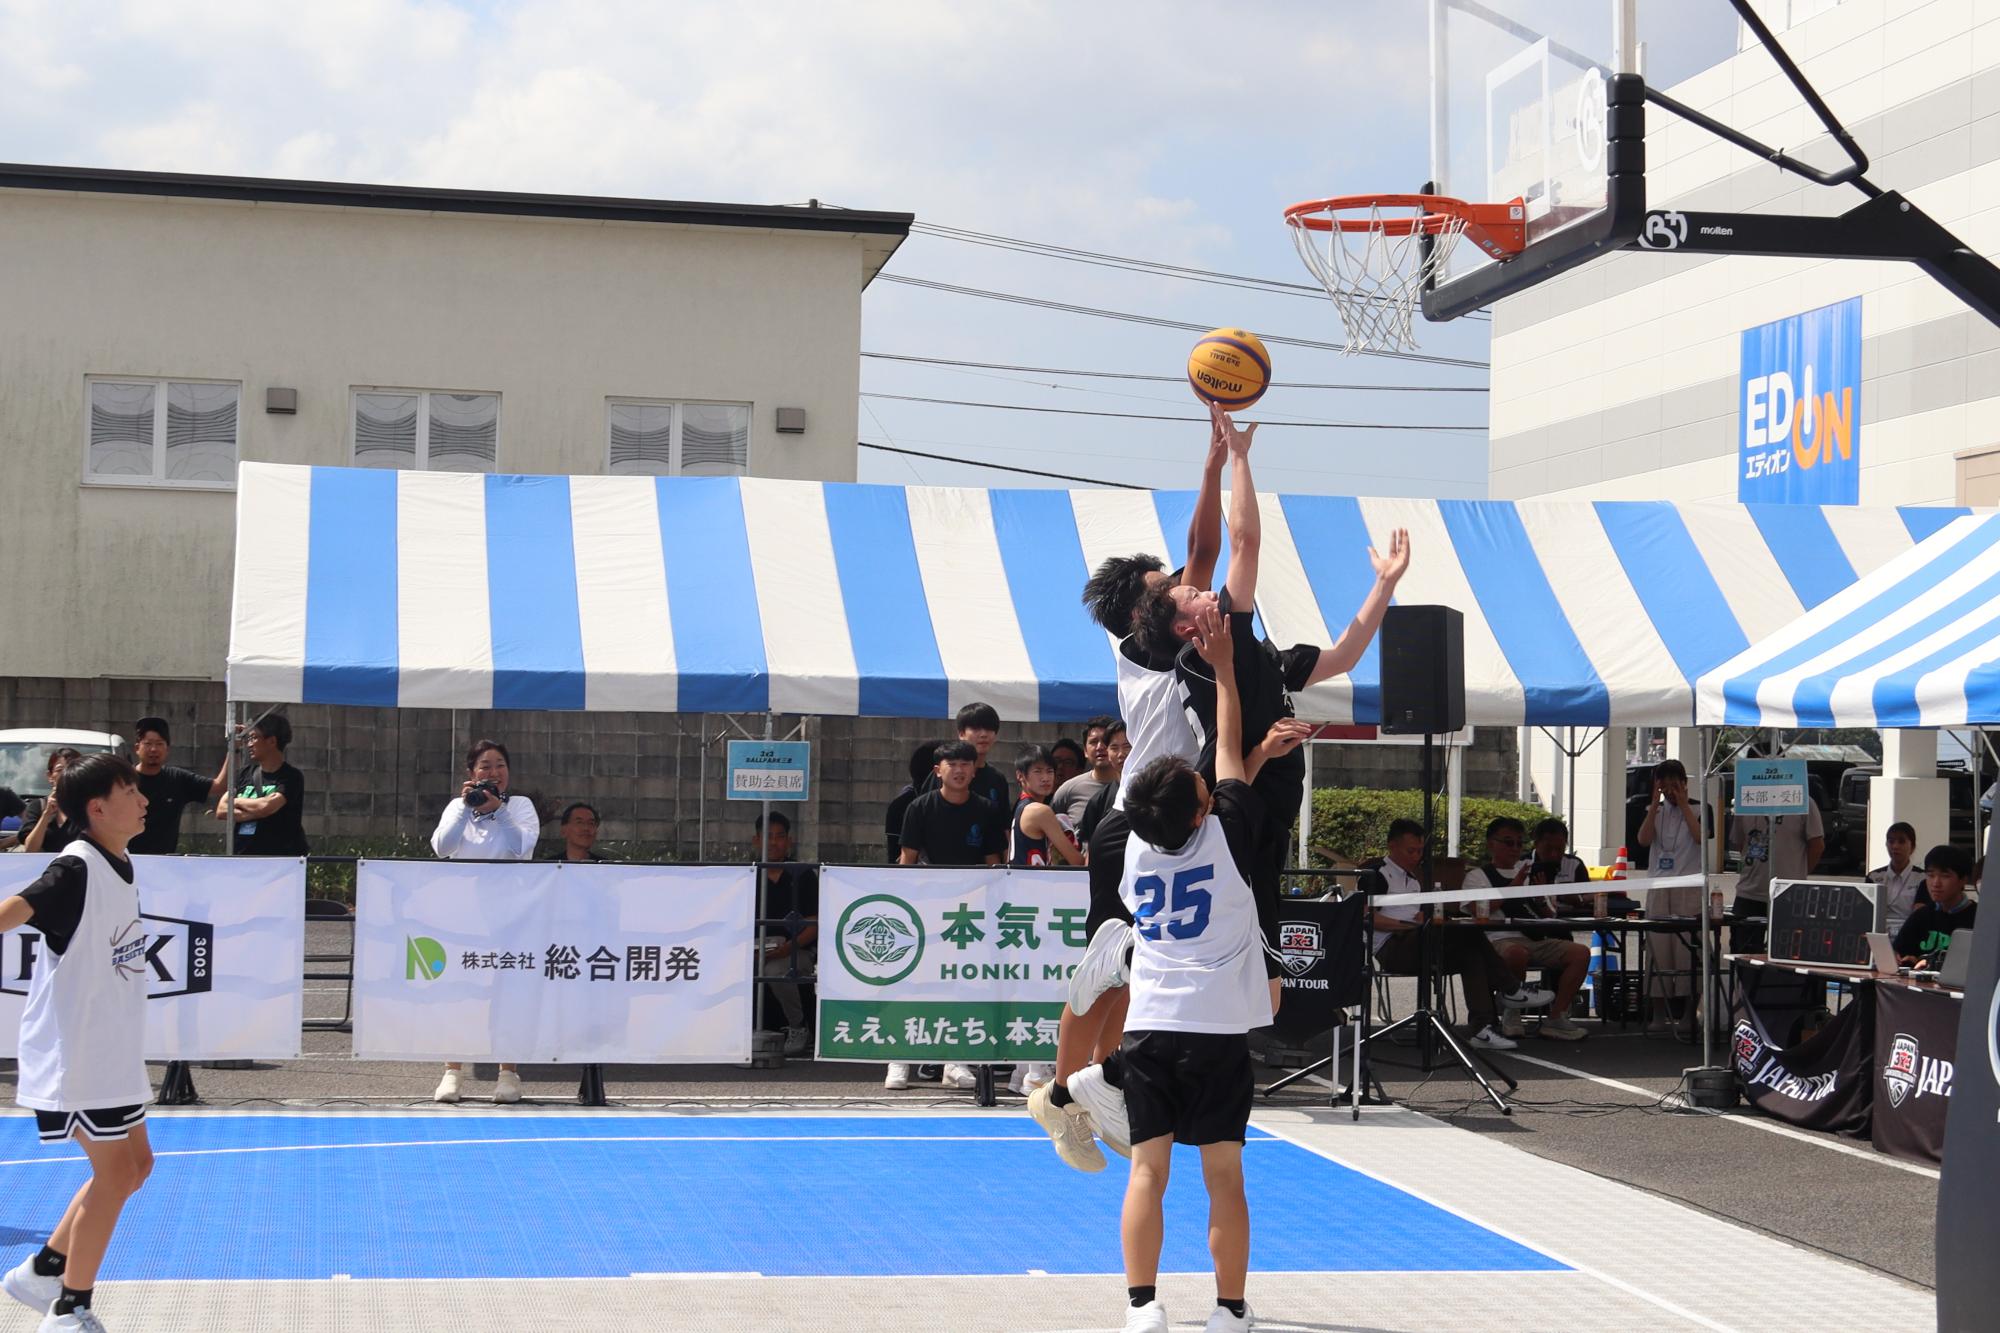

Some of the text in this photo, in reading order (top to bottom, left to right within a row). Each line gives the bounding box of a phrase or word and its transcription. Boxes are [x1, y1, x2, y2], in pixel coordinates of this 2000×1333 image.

[1700, 226, 1733, 236] molten
[1197, 370, 1242, 392] molten
[1746, 364, 1853, 471] EDION
[1745, 449, 1791, 479] エディオン
[736, 774, 802, 788] 賛助会員席
[1743, 790, 1802, 804] 本部・受付
[1133, 863, 1214, 941] 25
[940, 902, 1087, 951] 本気モ
[1283, 927, 1315, 935] JAPAN
[194, 937, 207, 978] 3003
[461, 944, 701, 981] 株式会社 総合開発
[940, 963, 1030, 981] HONKI
[1297, 979, 1330, 990] TOUR
[1897, 1042, 1915, 1053] JAPAN
[1914, 1055, 1953, 1099] JAP
